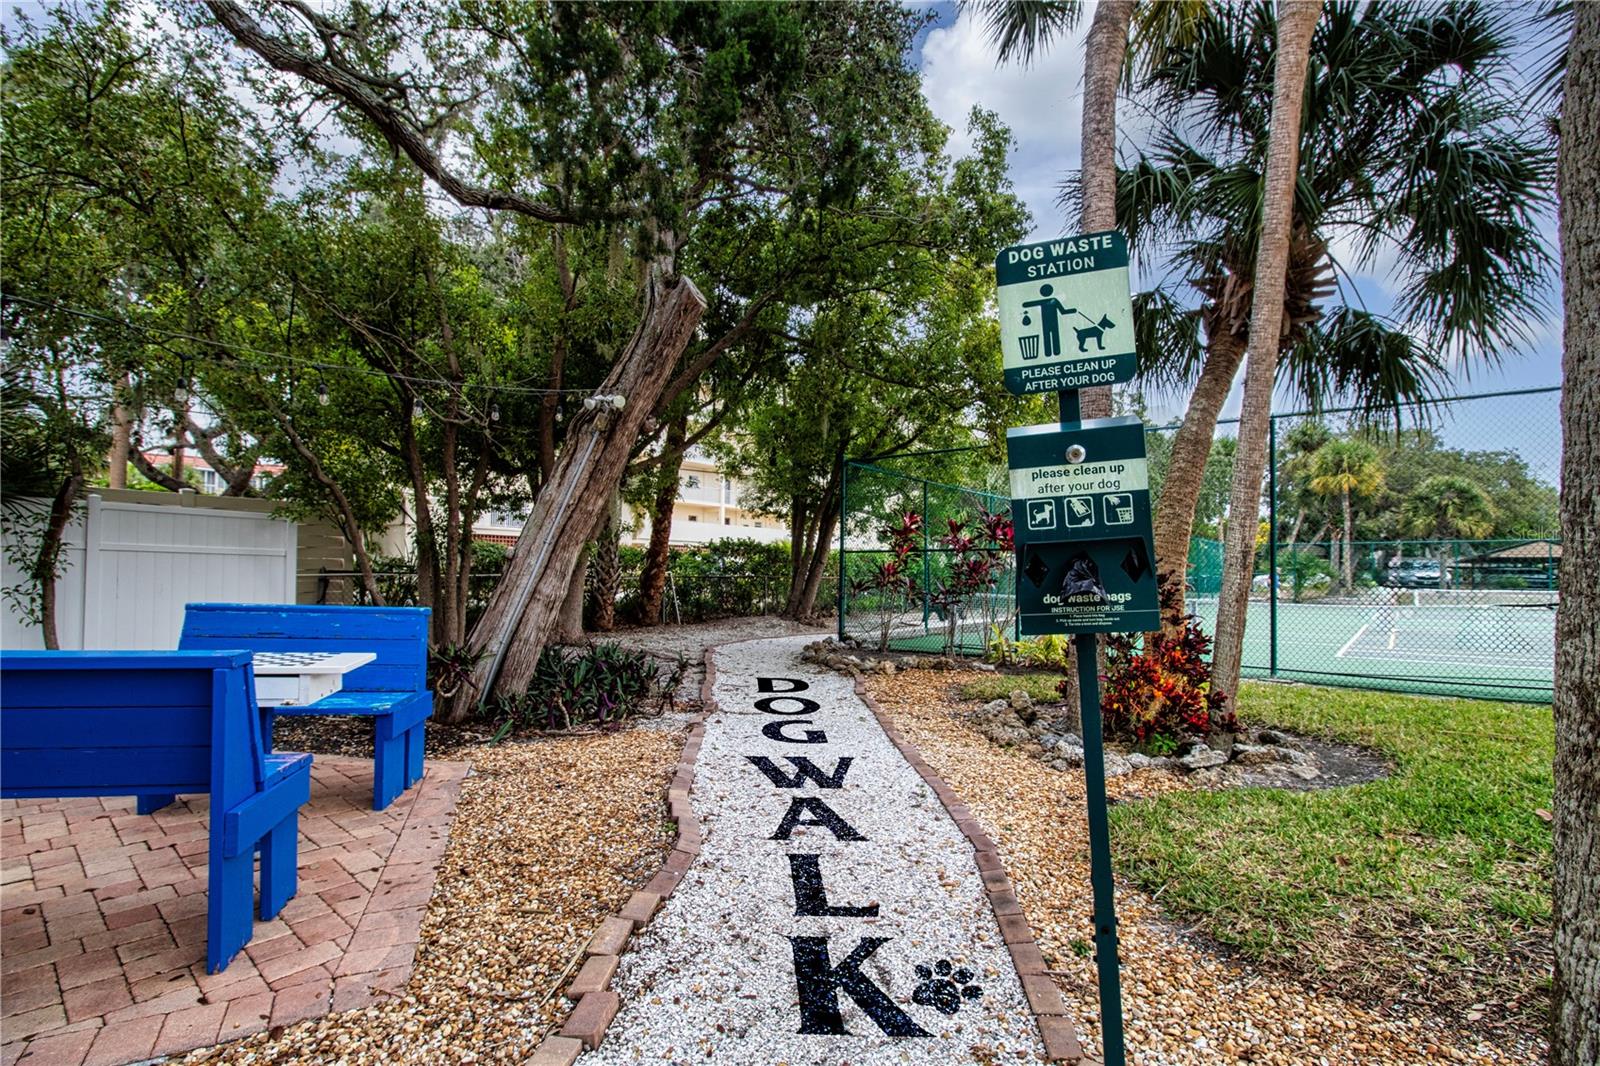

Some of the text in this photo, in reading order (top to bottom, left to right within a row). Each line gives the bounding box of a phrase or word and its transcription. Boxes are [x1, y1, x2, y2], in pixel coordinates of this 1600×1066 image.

[1008, 235, 1112, 264] DOG WASTE
[1027, 256, 1095, 278] STATION
[1021, 359, 1116, 380] PLEASE CLEAN UP
[1024, 372, 1116, 392] AFTER YOUR DOG
[1031, 464, 1125, 481] please clean up
[1037, 479, 1121, 494] after your dog
[744, 677, 937, 1038] DOG WALK
